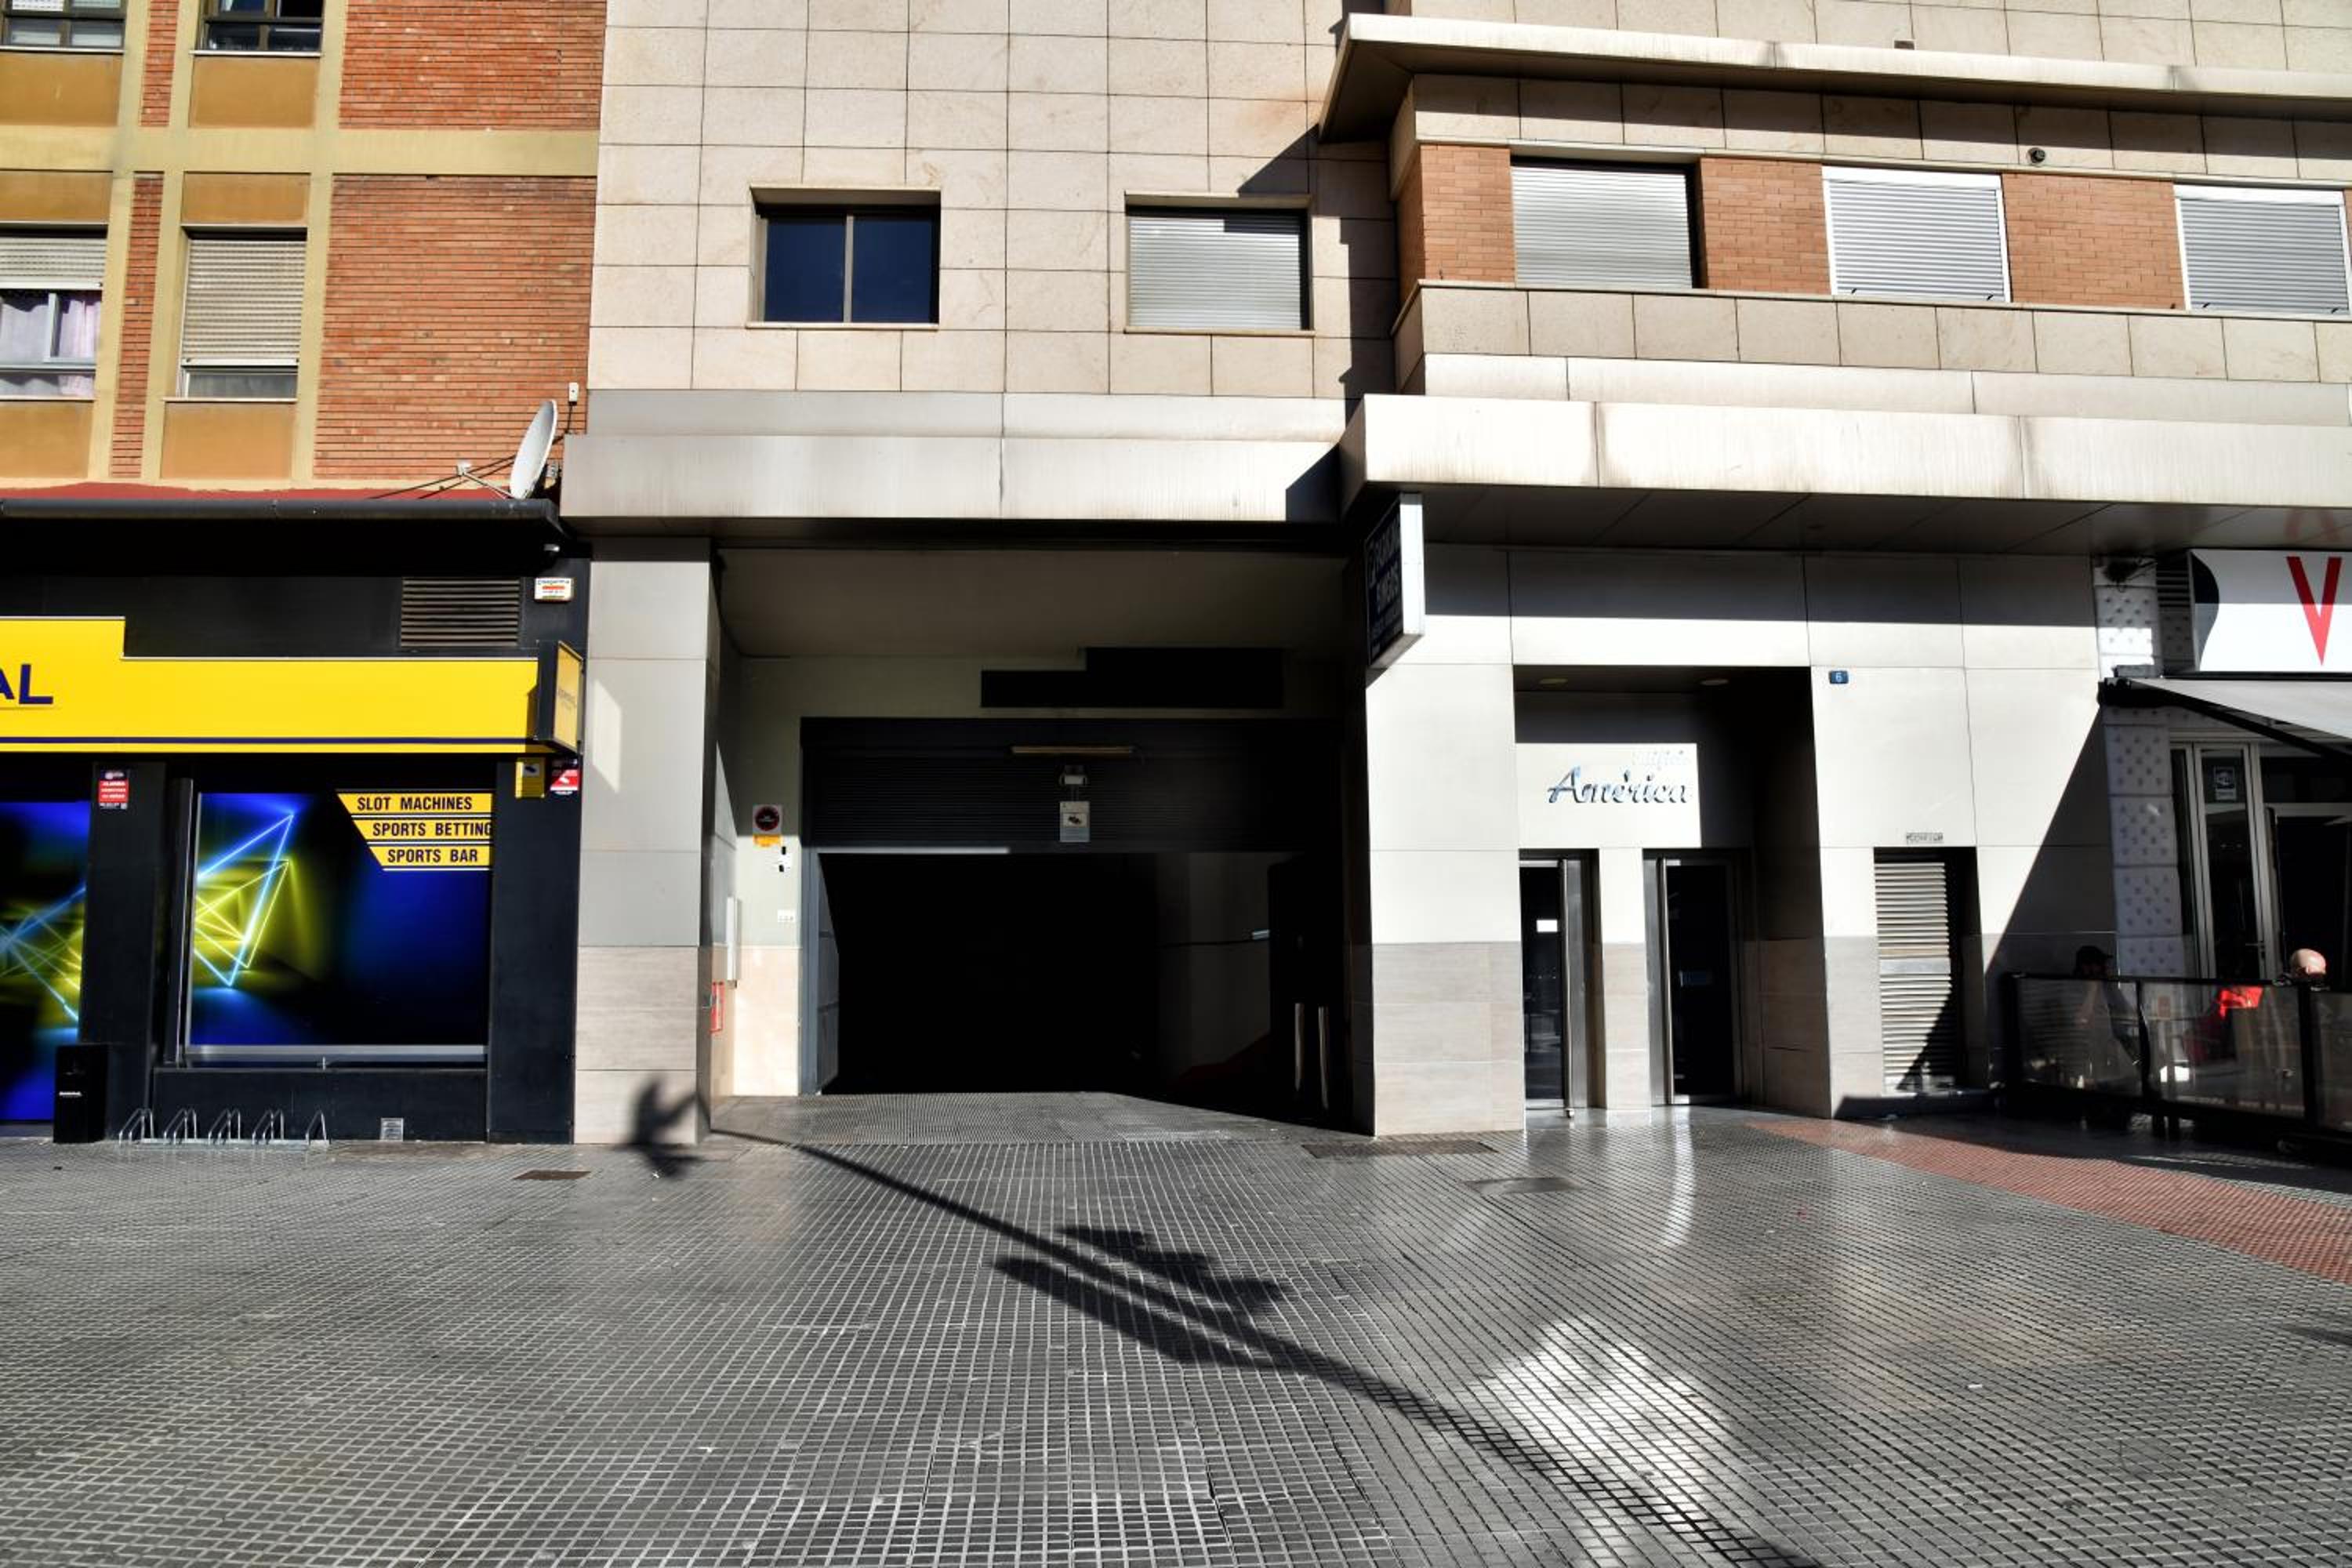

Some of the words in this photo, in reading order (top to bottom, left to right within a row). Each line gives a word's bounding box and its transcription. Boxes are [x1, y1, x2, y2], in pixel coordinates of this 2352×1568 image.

[1547, 764, 1689, 804] América
[357, 797, 391, 811] SLOT
[401, 796, 473, 810] MACHINES
[372, 822, 426, 837] SPORTS
[435, 822, 492, 836] BETTING
[387, 849, 441, 862] SPORTS
[450, 848, 478, 862] BAR
